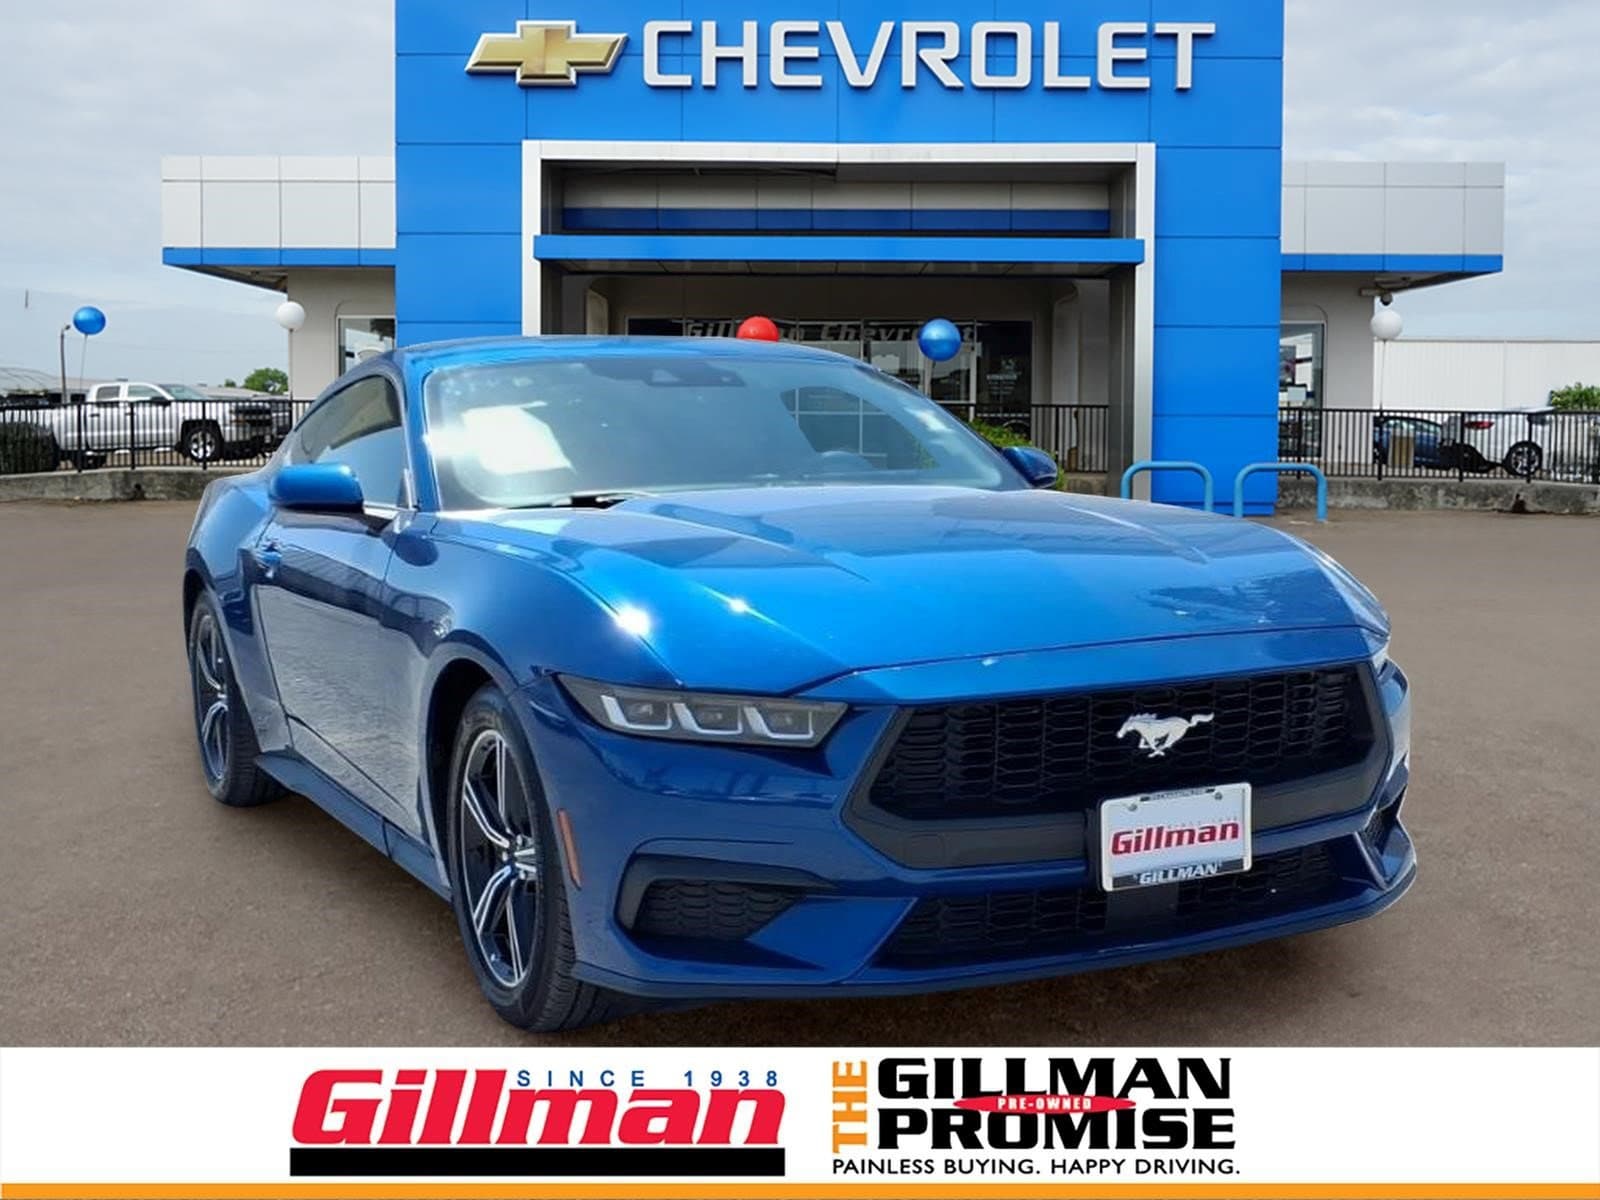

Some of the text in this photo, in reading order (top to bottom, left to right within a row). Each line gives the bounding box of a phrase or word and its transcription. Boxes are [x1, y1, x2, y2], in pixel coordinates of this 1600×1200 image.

[643, 20, 1217, 90] CHEVROLET
[686, 323, 973, 342] Gilln Chevrt
[1111, 822, 1239, 855] Gillman
